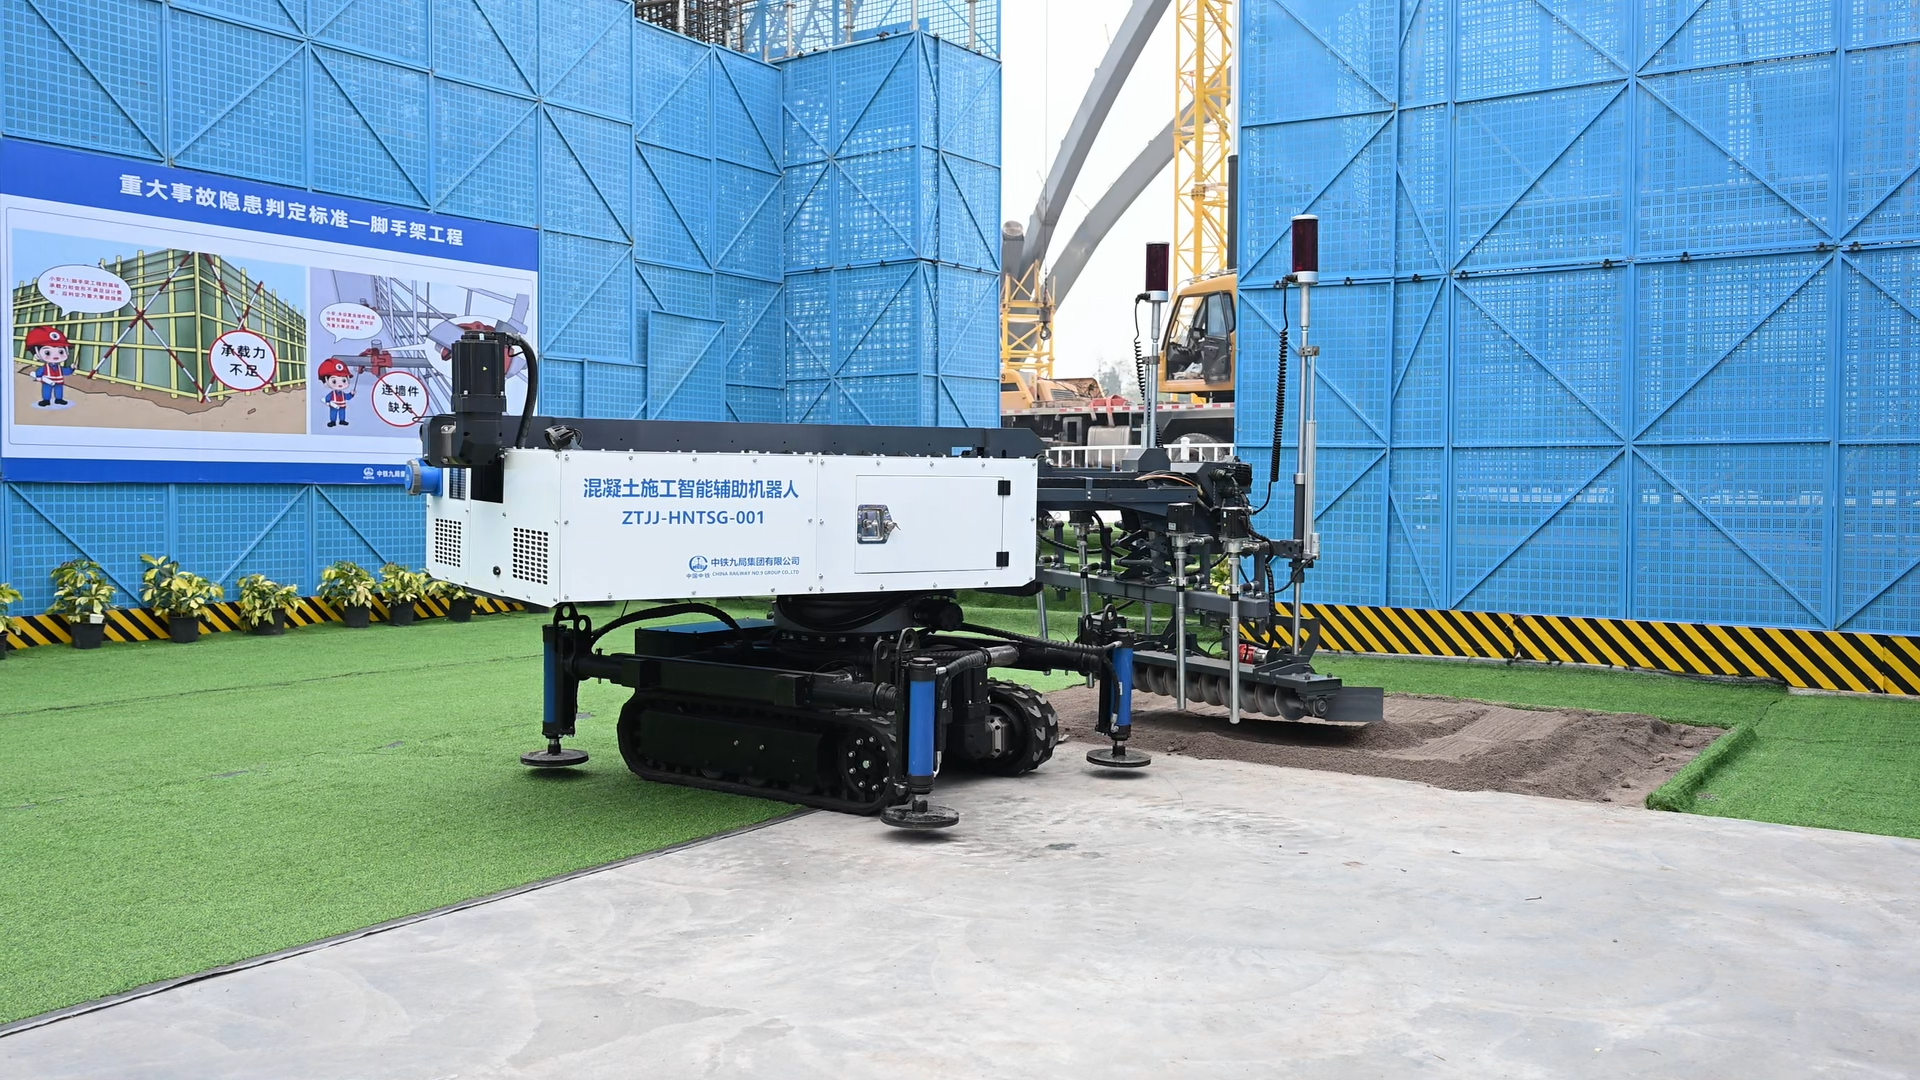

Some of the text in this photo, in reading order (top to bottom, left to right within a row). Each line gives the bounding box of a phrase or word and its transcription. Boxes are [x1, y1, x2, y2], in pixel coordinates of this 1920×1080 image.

[220, 343, 266, 360] 承载力
[230, 363, 258, 377] 不足
[381, 384, 419, 397] 连墙件
[388, 401, 413, 414] 缺失
[583, 478, 799, 499] 混凝土施工智能辅助机器人
[621, 510, 764, 525] ZTJJ-HNTSG-001
[711, 556, 800, 567] 中铁九局集团有限公司
